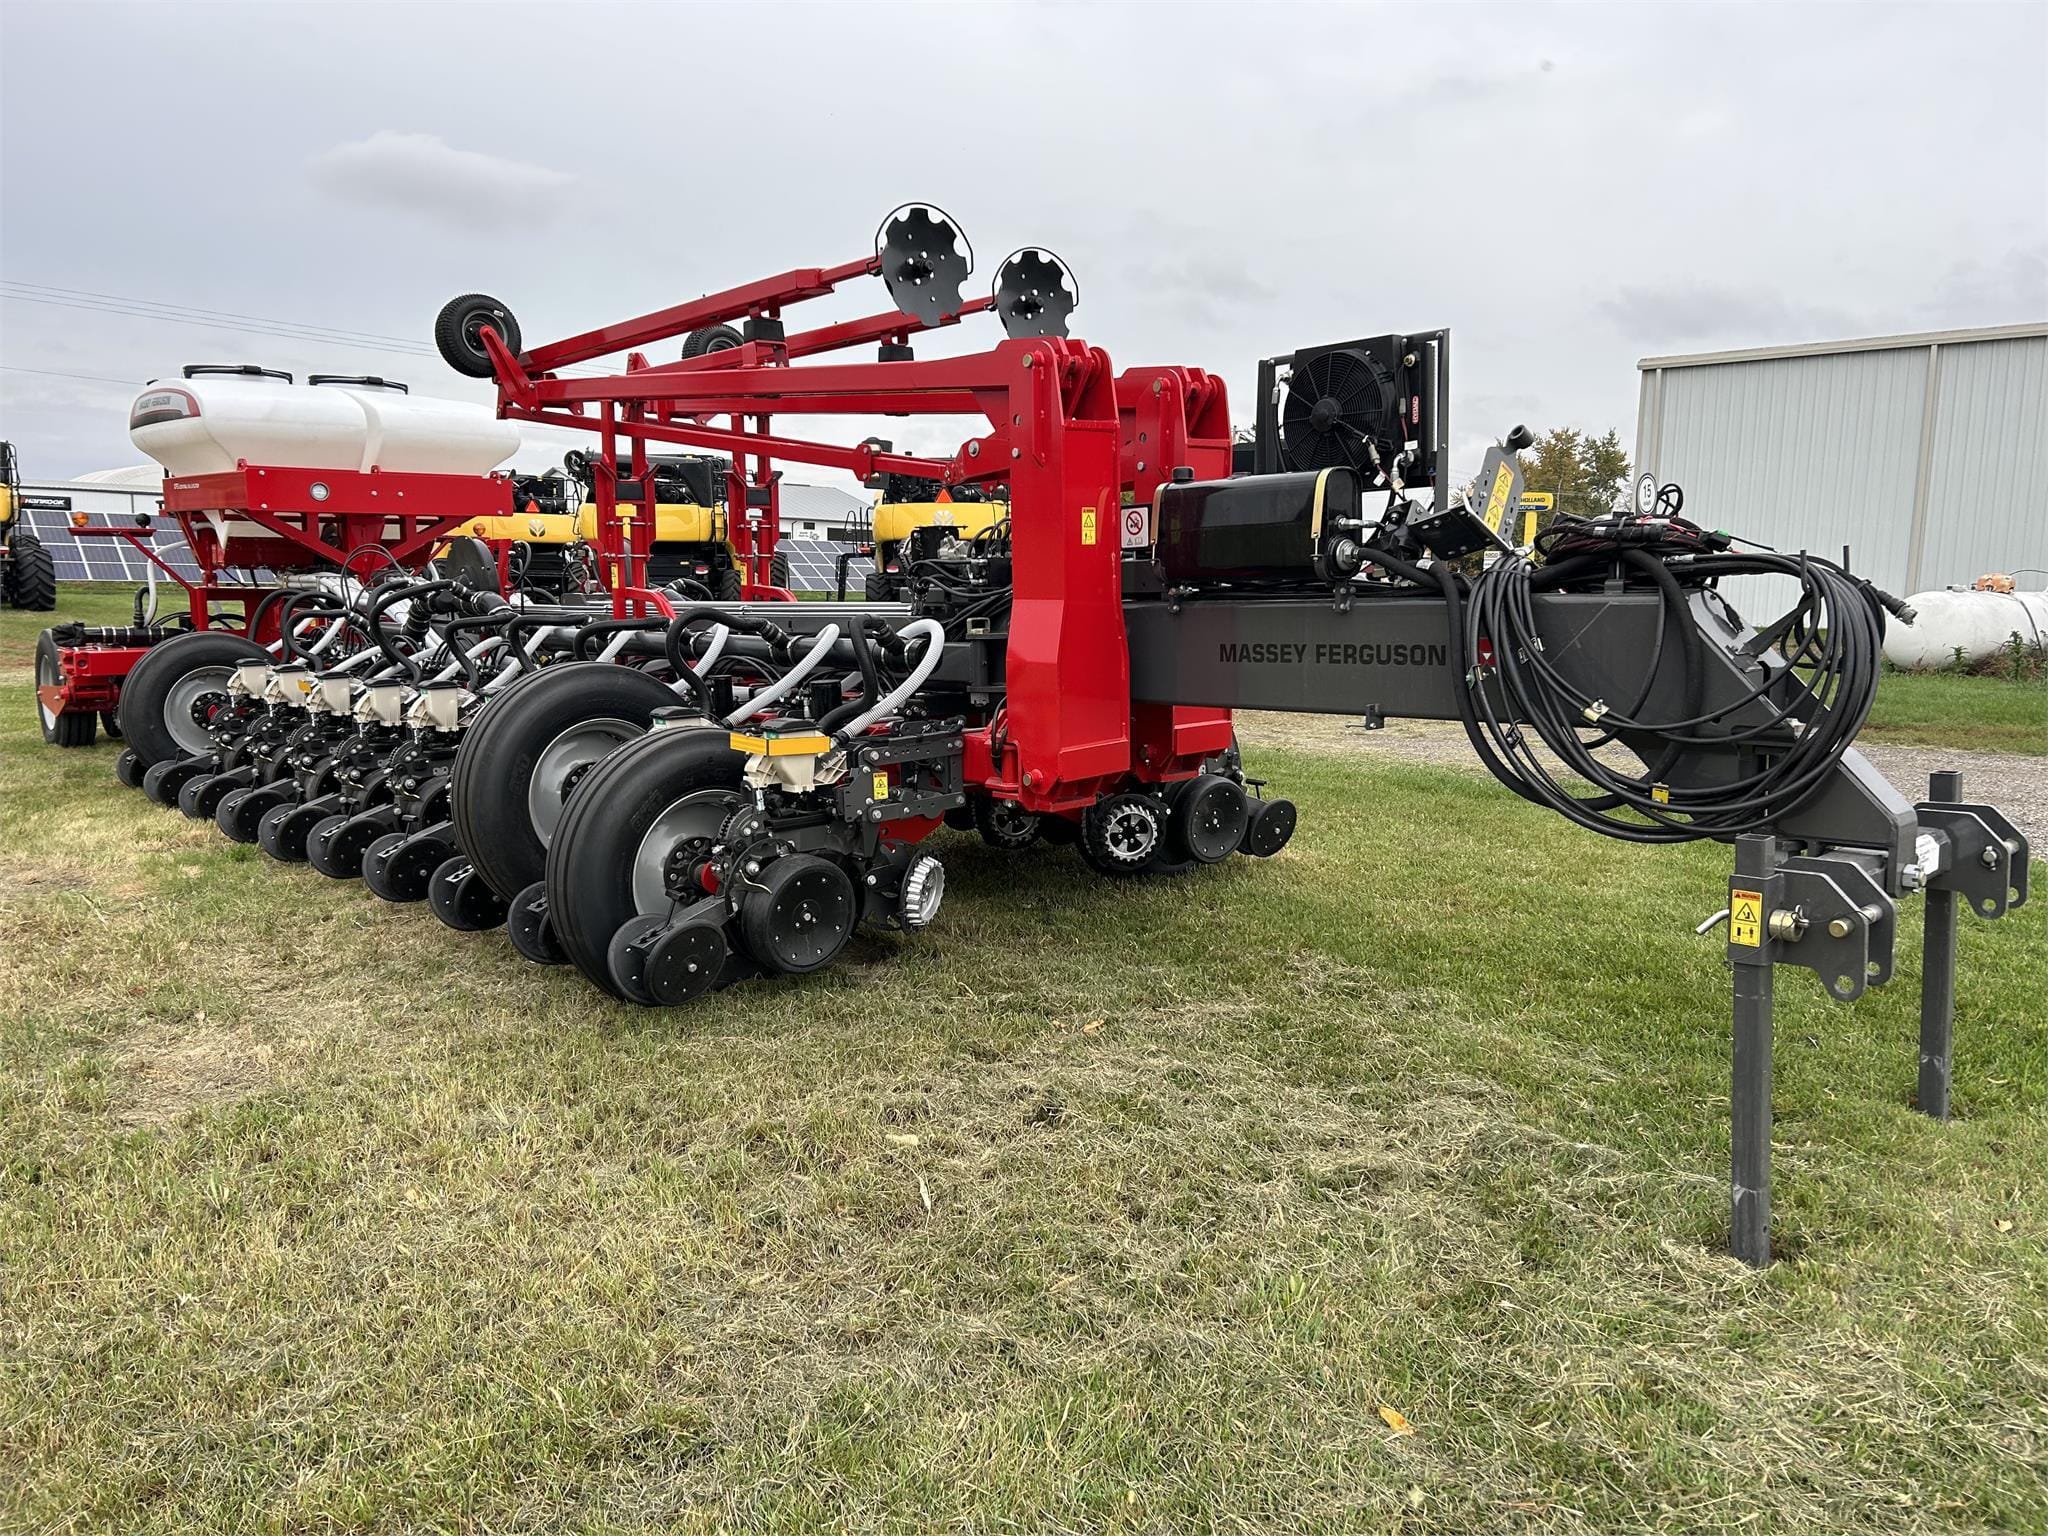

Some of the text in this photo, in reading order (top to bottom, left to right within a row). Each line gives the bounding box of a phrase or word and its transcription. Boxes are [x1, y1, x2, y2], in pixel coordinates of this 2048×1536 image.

[1643, 484, 1651, 498] 15
[1219, 643, 1447, 666] MASSEY FERGUSON
